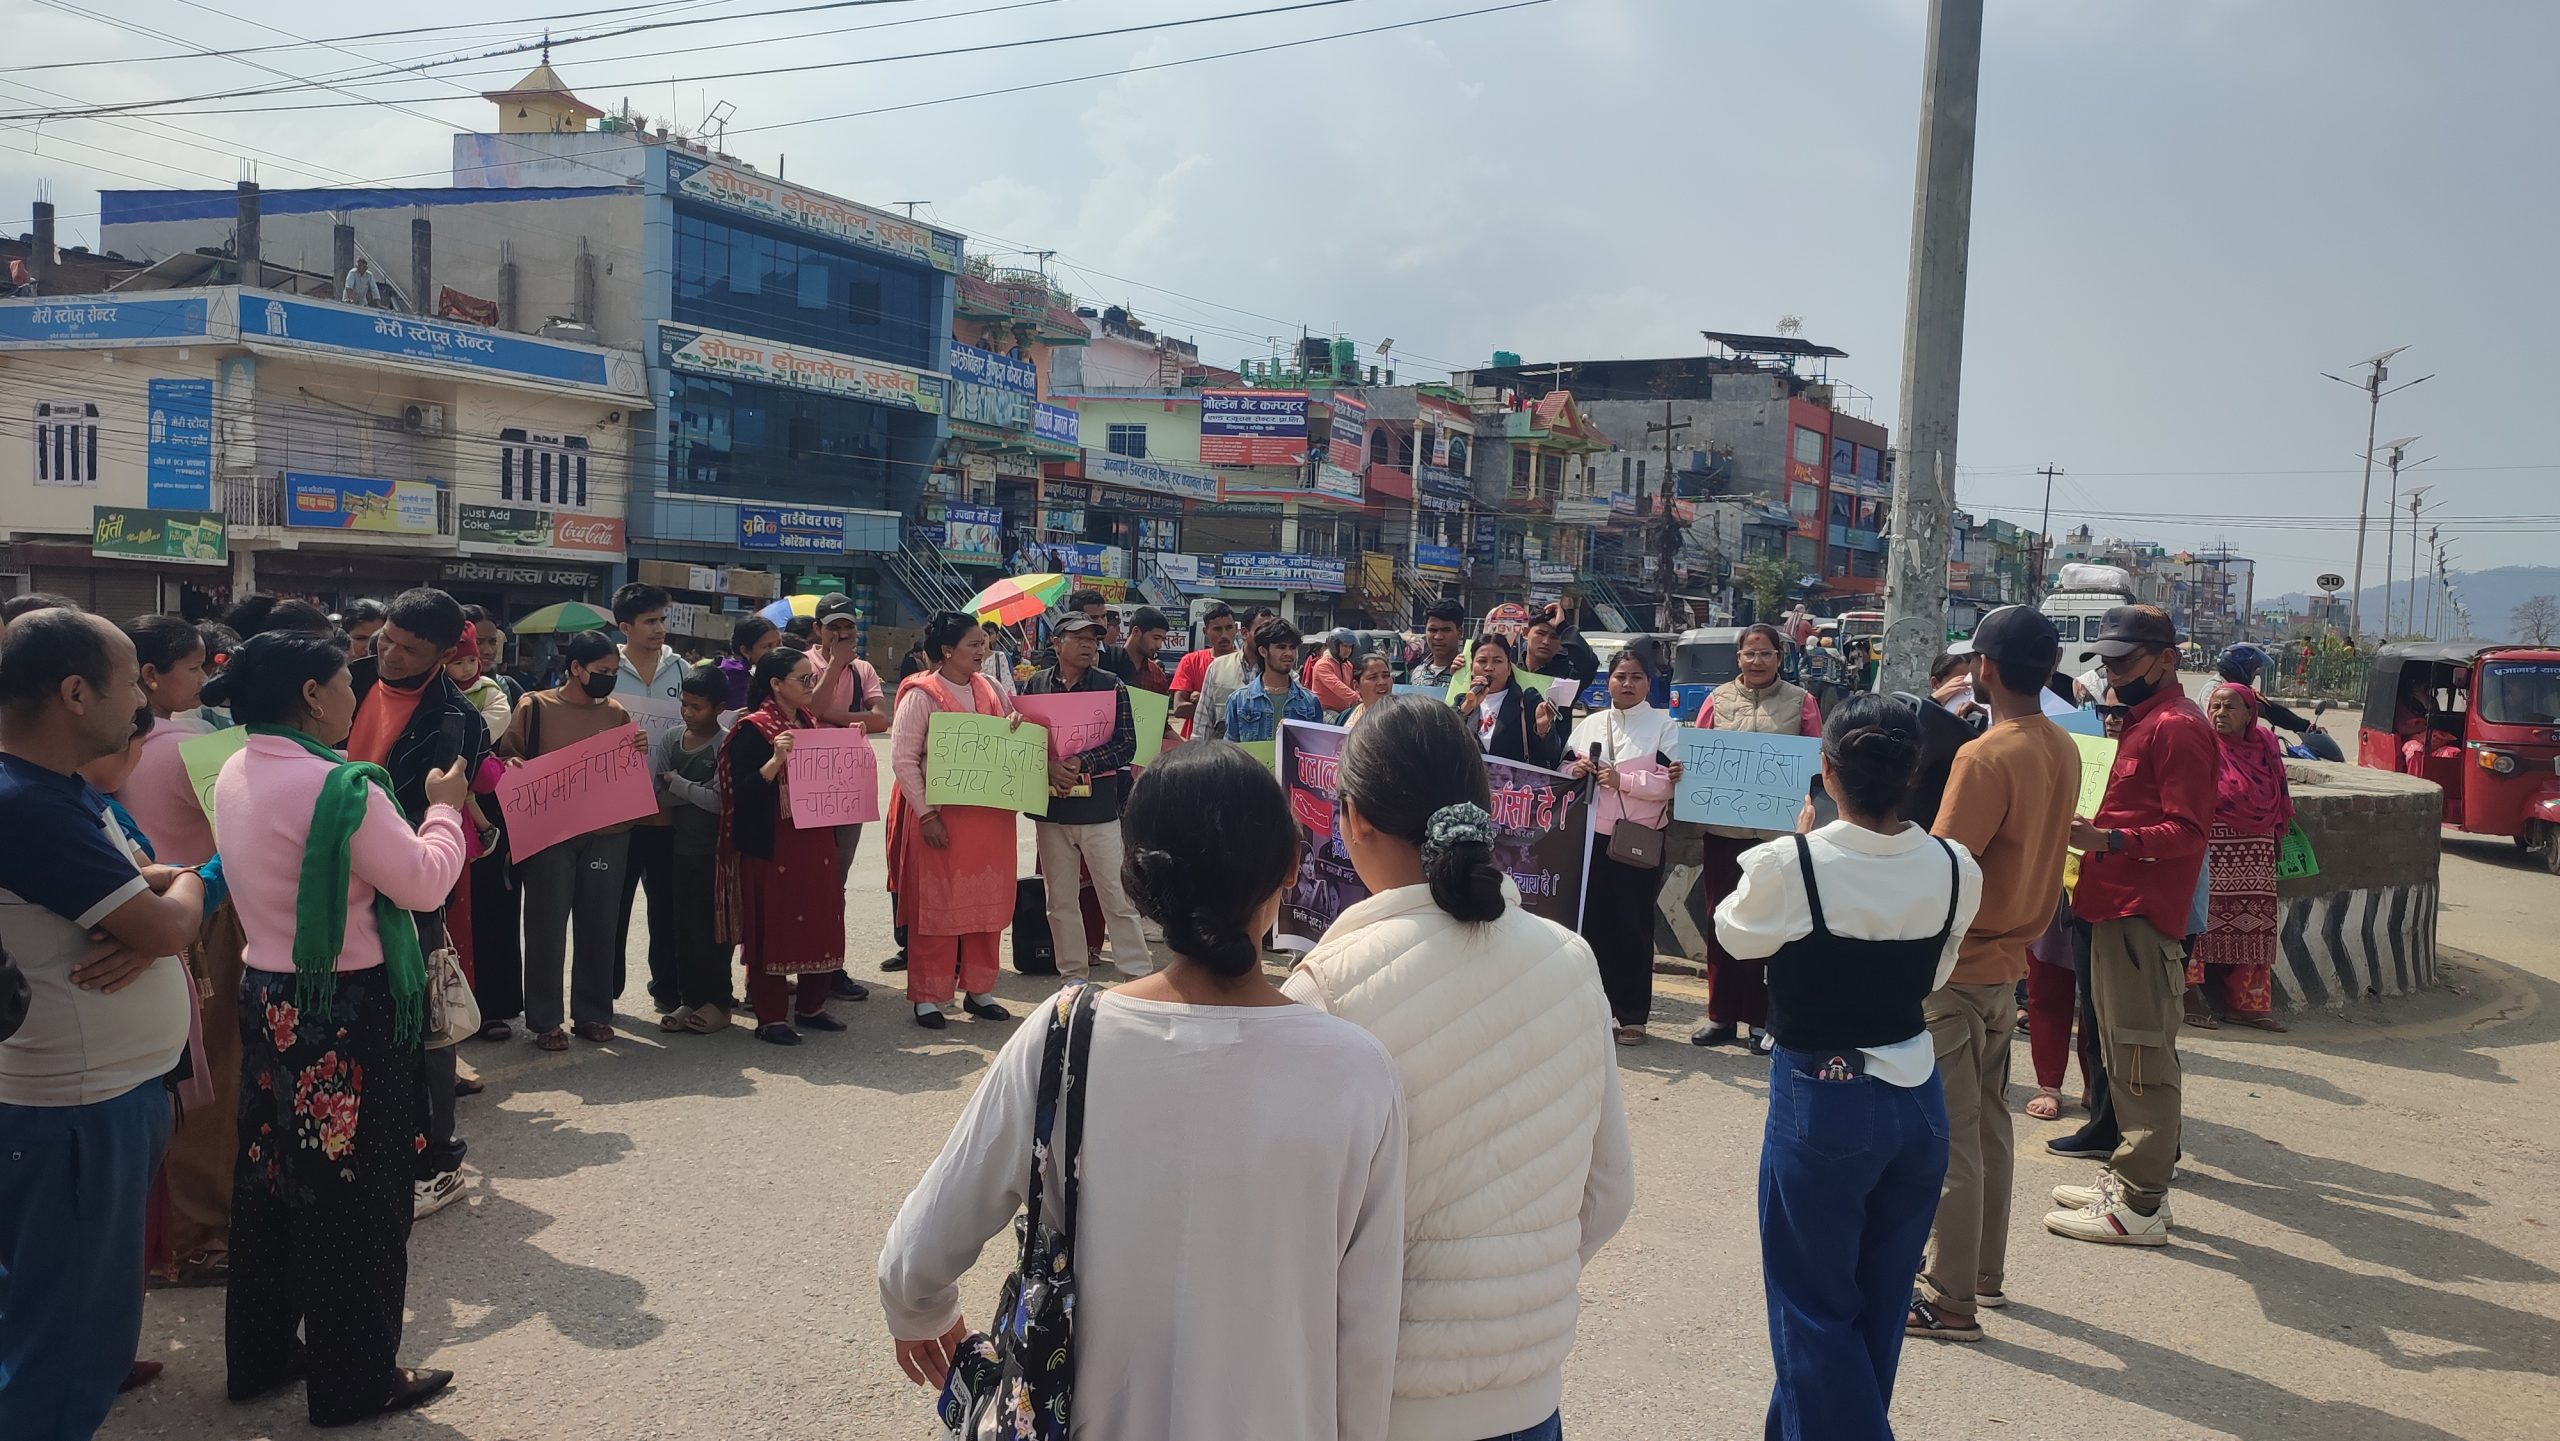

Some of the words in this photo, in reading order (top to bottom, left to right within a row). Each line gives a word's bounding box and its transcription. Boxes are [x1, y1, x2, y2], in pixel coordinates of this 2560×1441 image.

[707, 170, 774, 201] सोफा
[780, 191, 869, 230] होलसेल
[875, 219, 930, 249] सुर्खेत
[32, 307, 51, 323] मेरी
[374, 317, 404, 338] मेरी
[455, 330, 495, 353] सेन्टर
[699, 338, 764, 364] सोफा
[771, 351, 857, 380] होलसेल
[862, 369, 917, 393] सुर्खेत
[1241, 397, 1257, 411] गेट
[463, 507, 486, 519] Just
[488, 509, 510, 521] Add
[445, 562, 494, 580] गरिमा
[497, 565, 544, 585] नास्ता
[548, 570, 590, 587] पसल
[2321, 577, 2340, 586] 30
